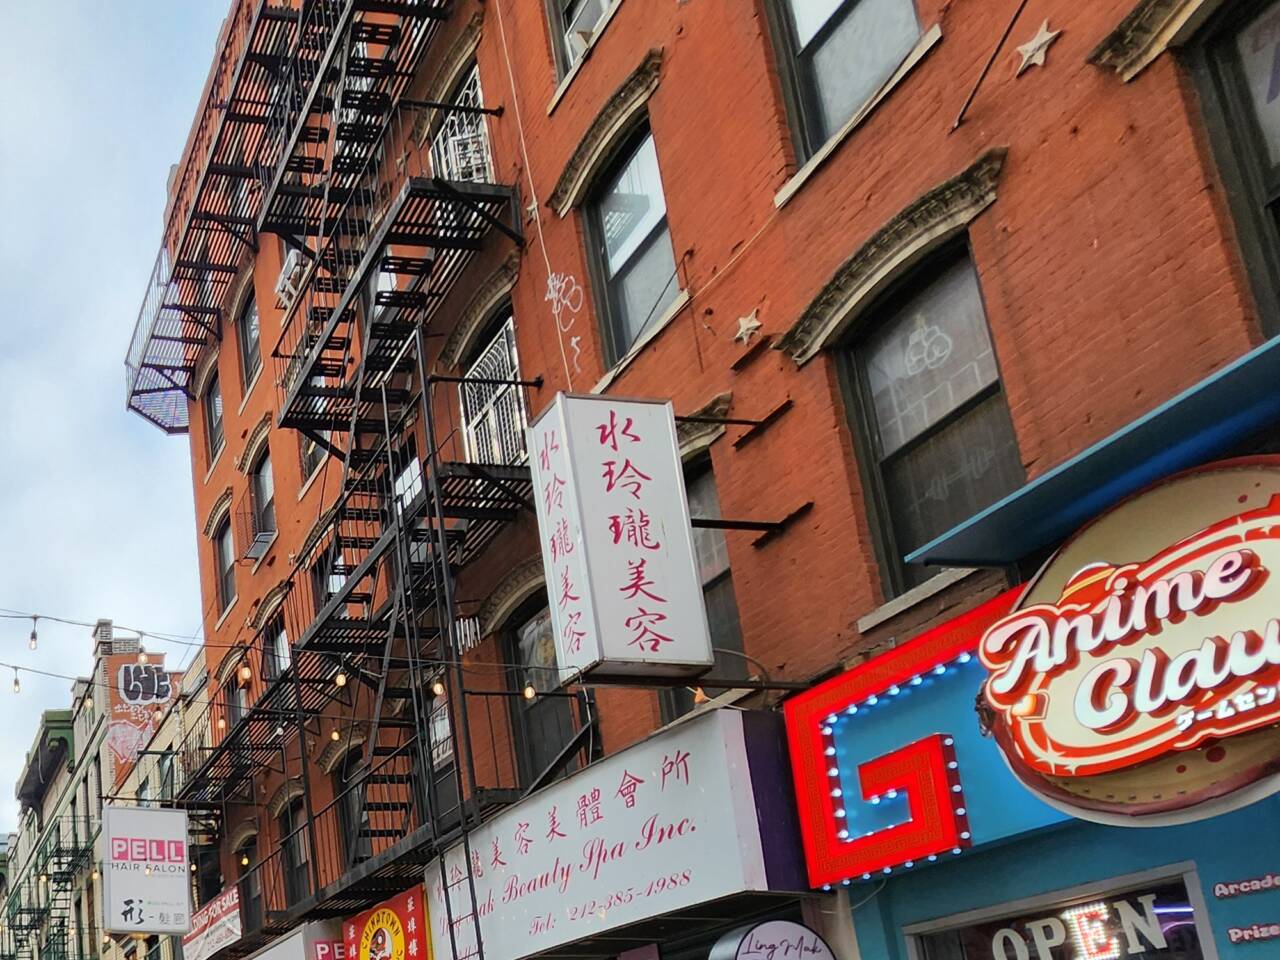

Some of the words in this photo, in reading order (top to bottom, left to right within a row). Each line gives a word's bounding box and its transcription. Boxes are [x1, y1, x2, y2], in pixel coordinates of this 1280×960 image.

[540, 430, 586, 655] 水玲瓏美容
[595, 409, 674, 652] 水玲瓏美容
[986, 550, 1257, 693] Anime
[1175, 682, 1280, 731] ゲームセン
[111, 863, 140, 871] HAIR
[145, 864, 185, 873] SALON
[113, 838, 184, 862] PELL
[502, 856, 574, 905] Beauty
[579, 837, 625, 881] Spa
[635, 814, 697, 849] Inc.
[222, 886, 240, 911] SALE
[529, 914, 556, 937] Tel:
[570, 869, 692, 922] 212-385-1988
[362, 911, 401, 949] CHINATOWN
[742, 933, 778, 960] Ling
